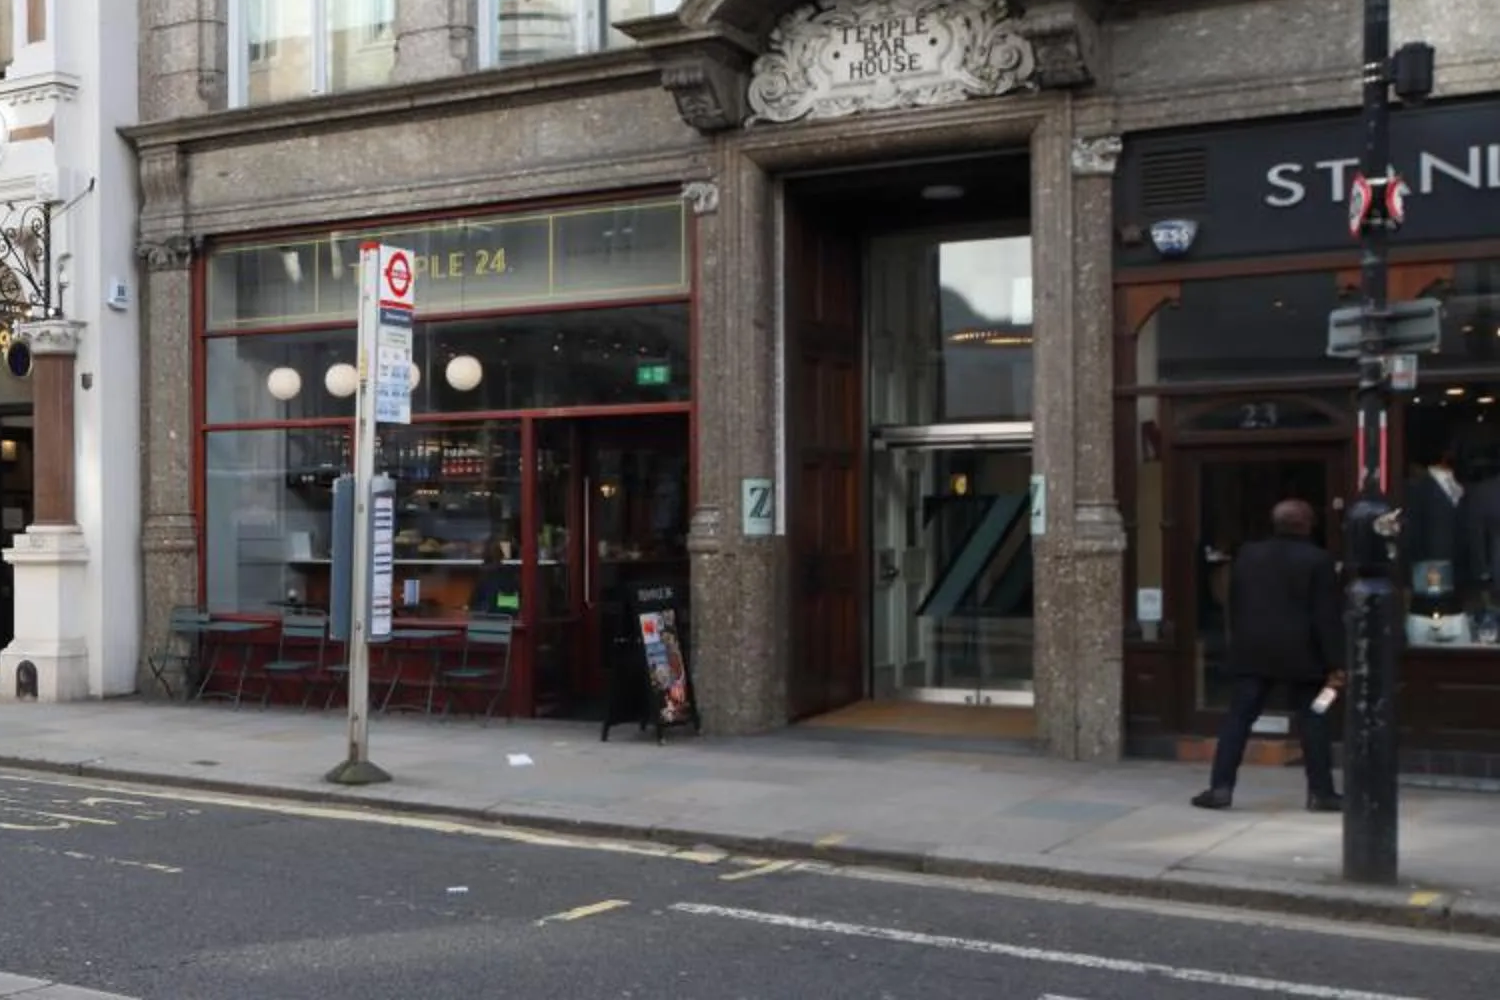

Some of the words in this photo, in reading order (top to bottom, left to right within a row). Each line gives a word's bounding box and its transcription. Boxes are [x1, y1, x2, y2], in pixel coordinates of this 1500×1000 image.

[837, 8, 929, 44] TEMPLE
[863, 37, 908, 60] BAR
[849, 53, 922, 80] HOUSE
[475, 247, 506, 276] 24
[749, 487, 771, 518] Z
